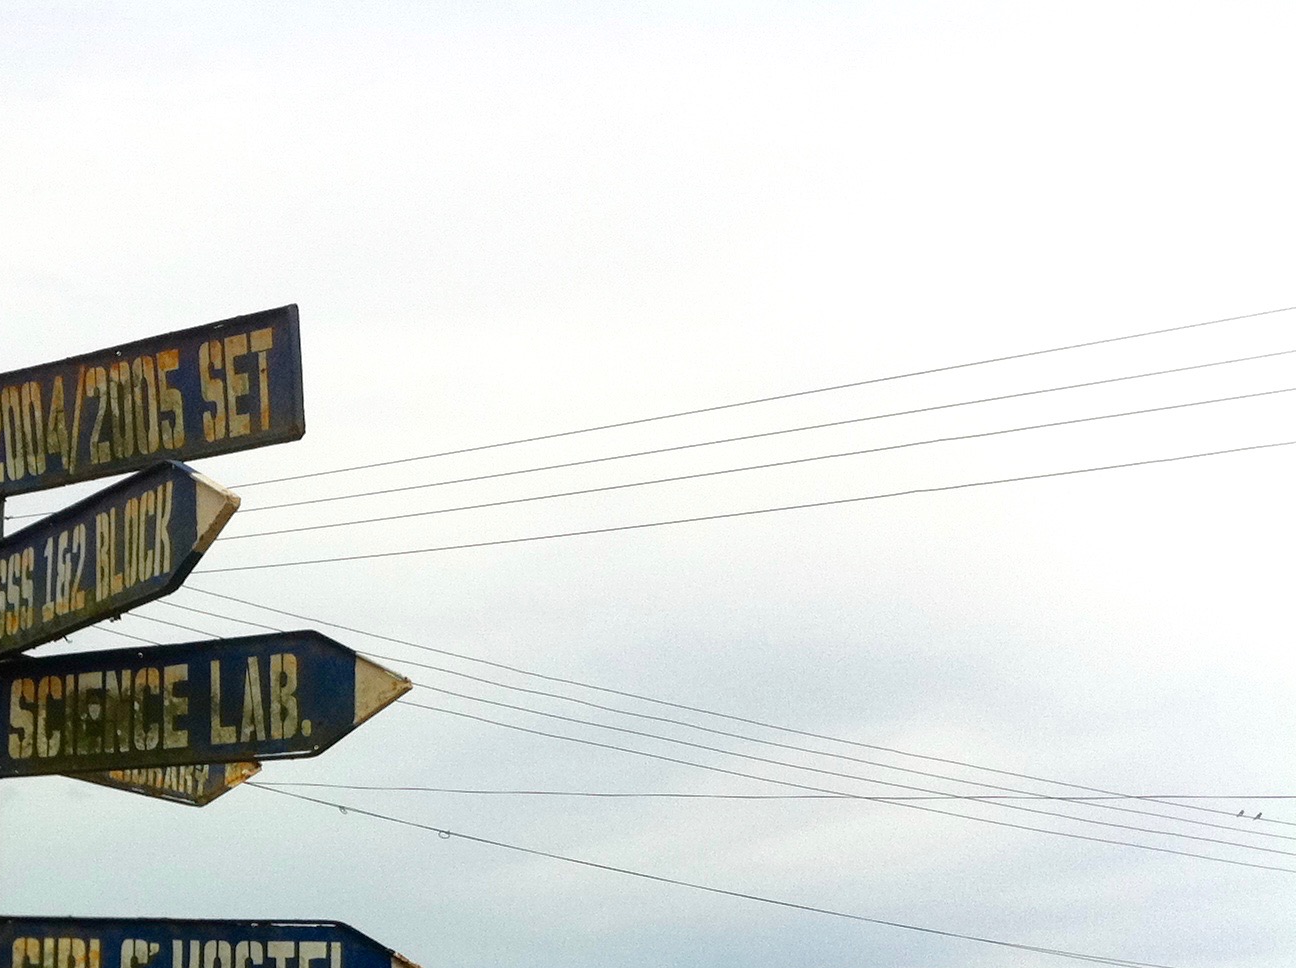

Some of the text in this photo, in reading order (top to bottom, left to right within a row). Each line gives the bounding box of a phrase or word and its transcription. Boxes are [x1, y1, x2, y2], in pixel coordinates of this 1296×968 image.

[198, 328, 274, 443] SET
[41, 522, 87, 623] 1&2
[95, 480, 174, 602] BLOCK
[7, 653, 312, 760] SCIENCE LAB.
